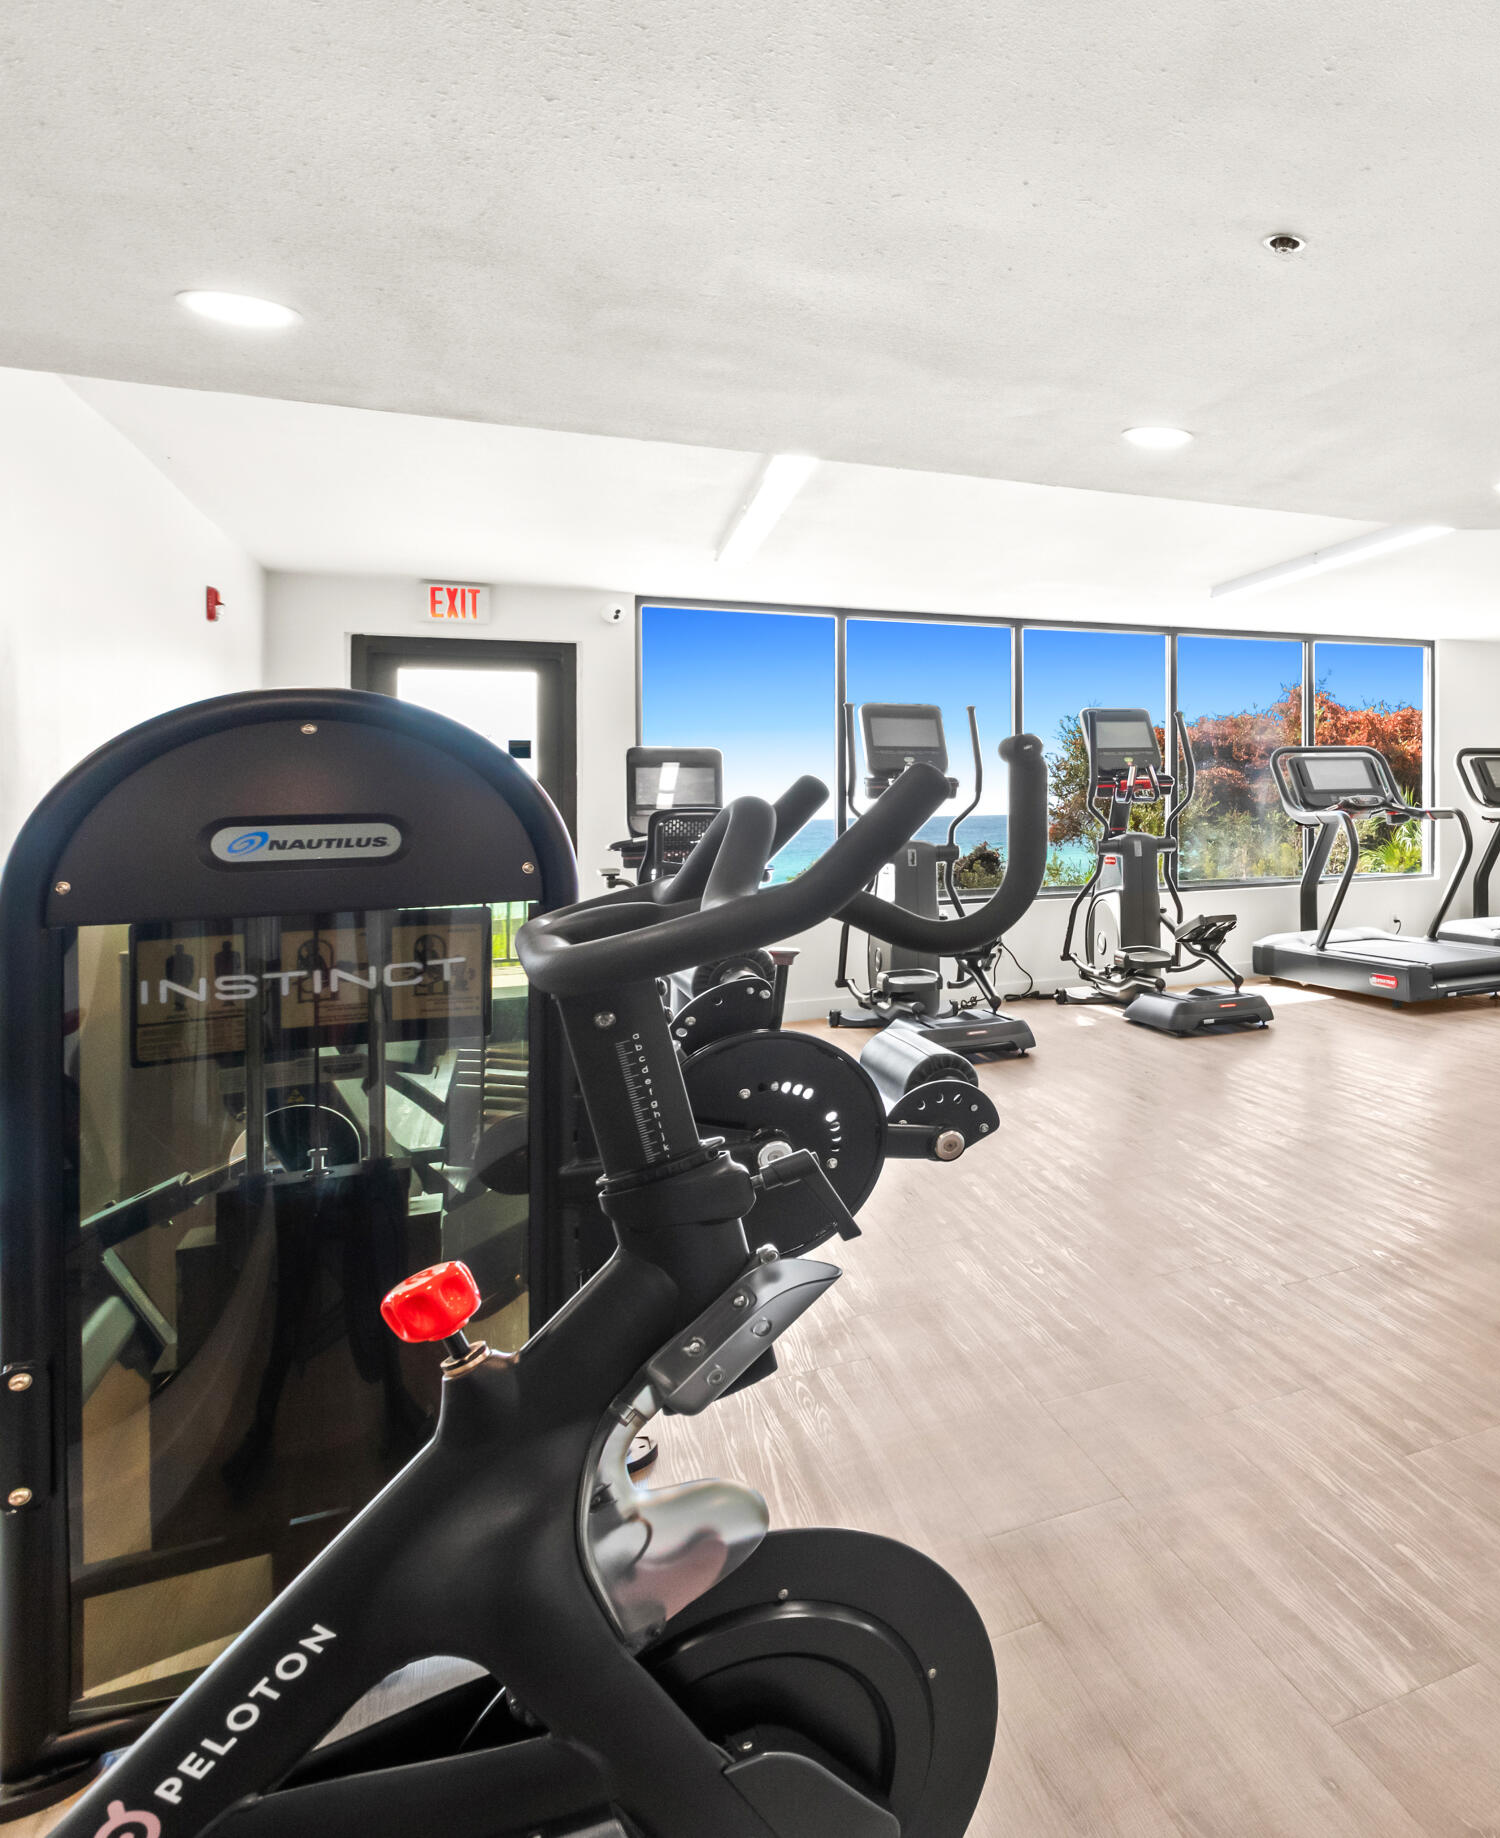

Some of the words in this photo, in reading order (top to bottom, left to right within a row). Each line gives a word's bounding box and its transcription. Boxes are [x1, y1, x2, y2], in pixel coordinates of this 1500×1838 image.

[429, 586, 480, 620] EXIT
[268, 836, 388, 851] NAUTILUS
[140, 953, 467, 1005] INSTINCT
[154, 1623, 337, 1804] PELOTON
